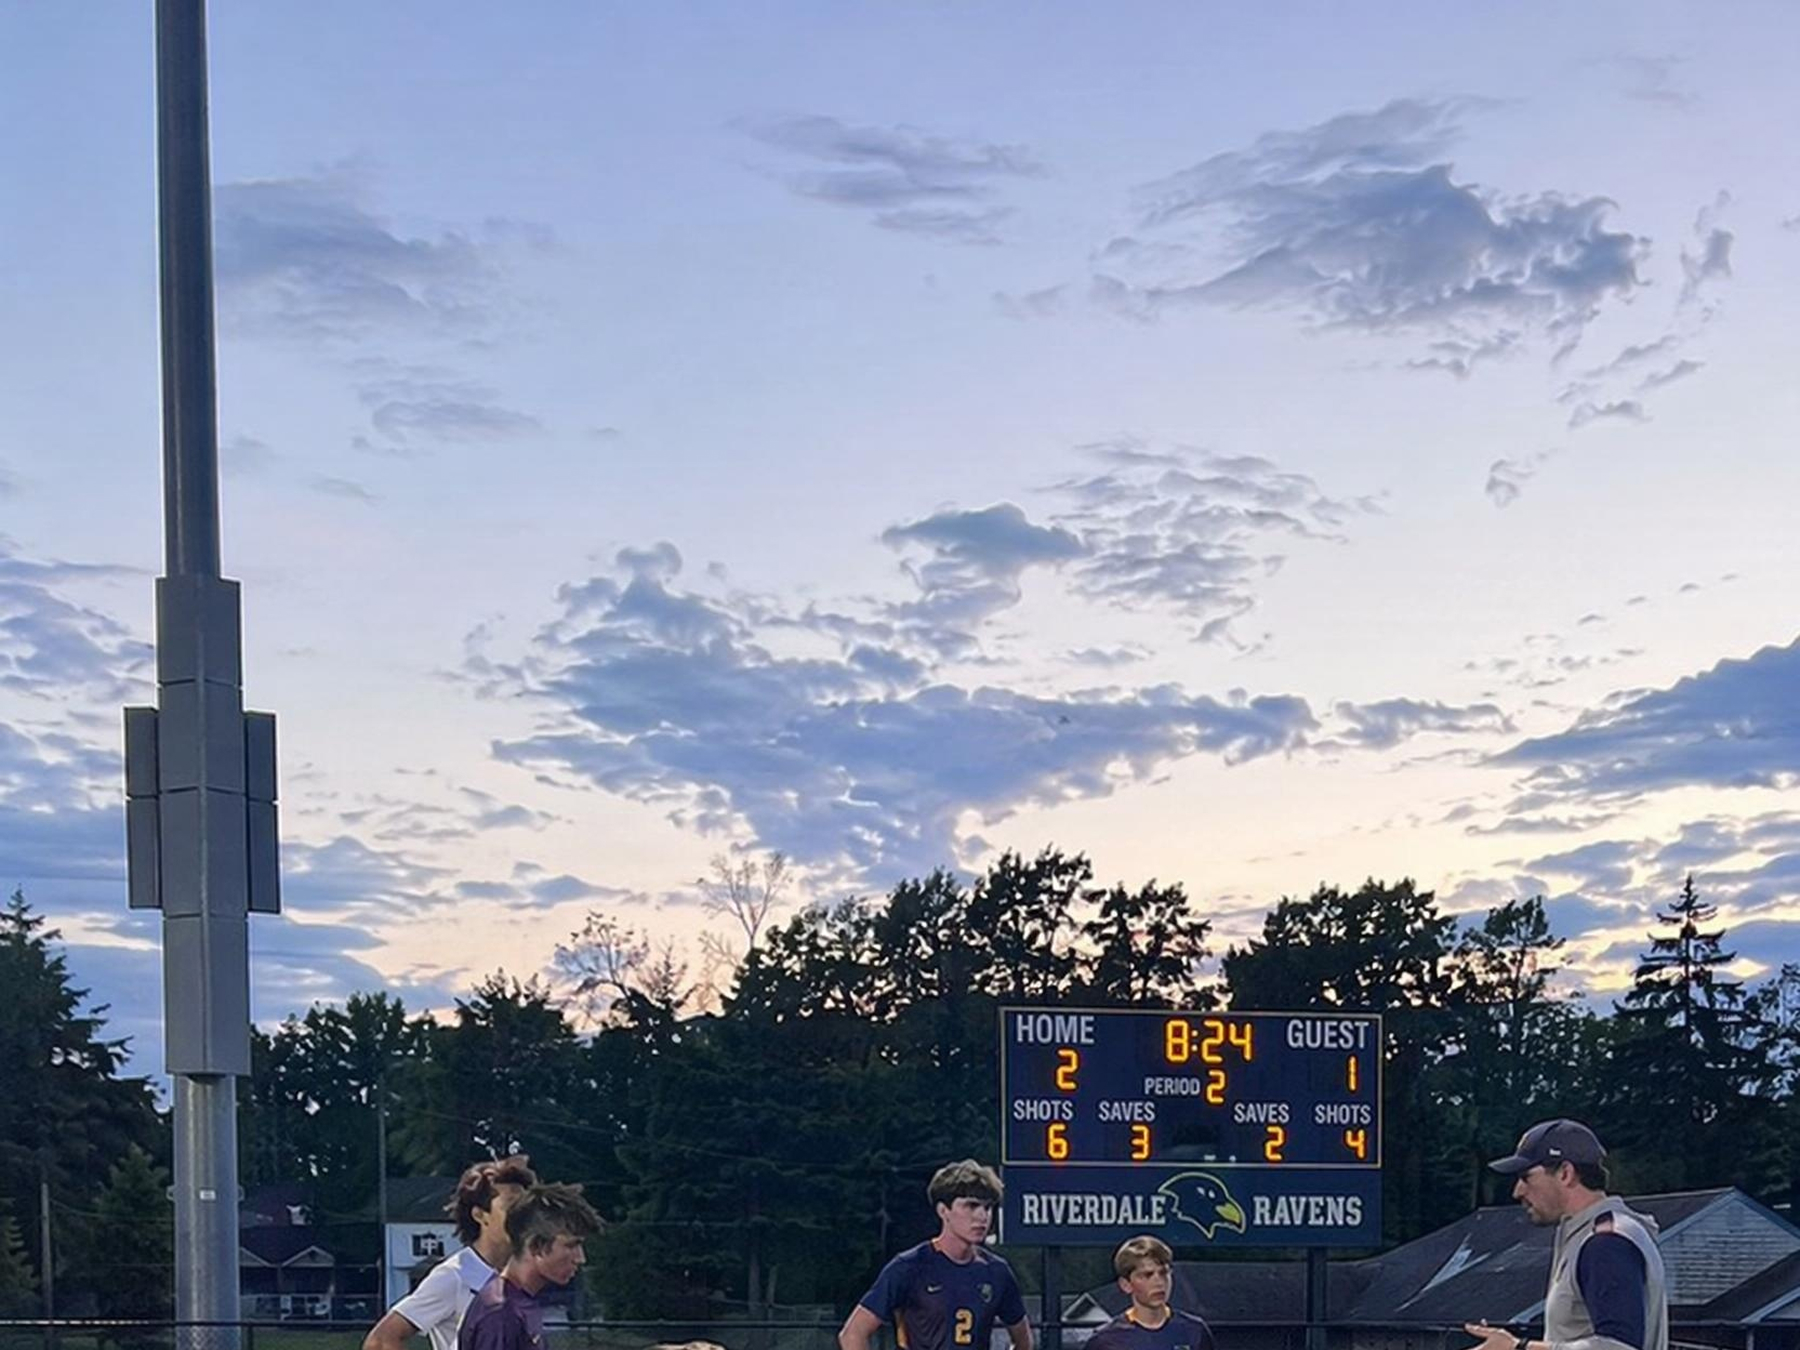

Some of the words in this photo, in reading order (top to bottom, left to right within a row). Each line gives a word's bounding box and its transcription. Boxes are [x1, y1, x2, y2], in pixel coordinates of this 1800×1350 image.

[1016, 1014, 1095, 1044] HOME
[1165, 1019, 1254, 1064] 8:24
[1287, 1019, 1370, 1049] GUEST
[1055, 1048, 1080, 1091] 2
[1347, 1055, 1358, 1091] 1
[1144, 1077, 1201, 1096] PERIOD
[1206, 1069, 1227, 1105] 2
[1013, 1099, 1074, 1121] SHOTS
[1098, 1101, 1156, 1122] SAVES
[1233, 1103, 1290, 1124] SAVES
[1314, 1104, 1371, 1125] SHOTS
[1047, 1123, 1069, 1160] 6
[1131, 1124, 1151, 1160] 3
[1264, 1125, 1286, 1161] 2
[1344, 1129, 1366, 1159] 4
[1022, 1194, 1167, 1225] RIVERDALE
[1252, 1196, 1363, 1226] RAVENS
[954, 1309, 974, 1344] 2
